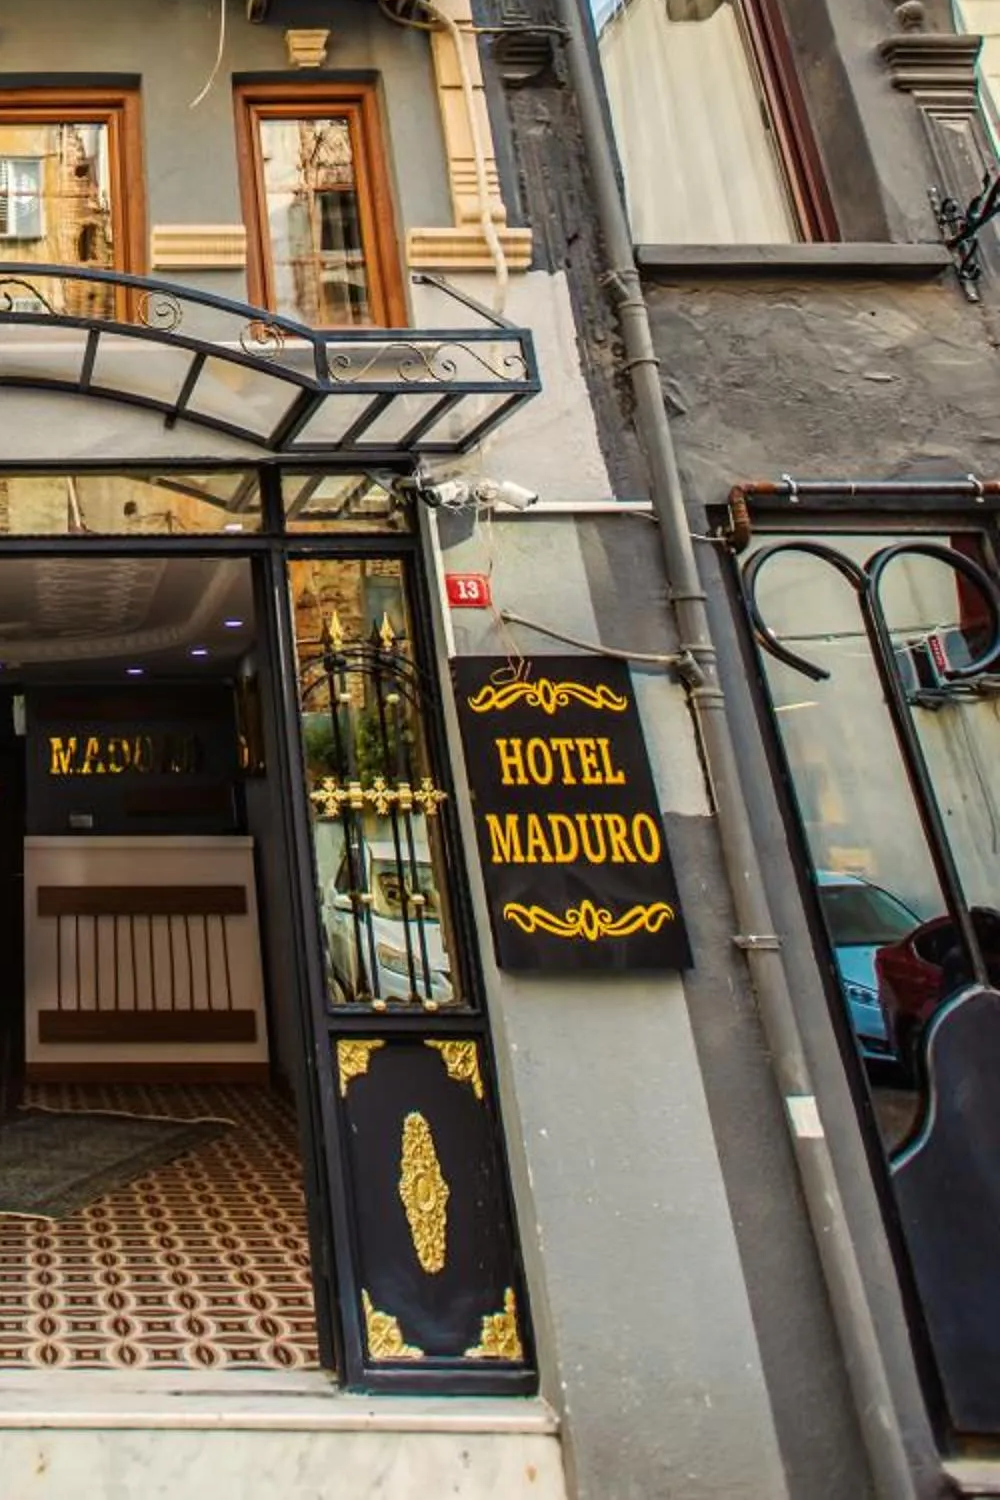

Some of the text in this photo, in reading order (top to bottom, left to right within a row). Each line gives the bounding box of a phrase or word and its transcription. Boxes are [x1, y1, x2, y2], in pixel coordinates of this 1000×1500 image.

[457, 580, 479, 599] 13
[496, 738, 626, 785] HOTEL
[486, 812, 661, 865] MADURO
